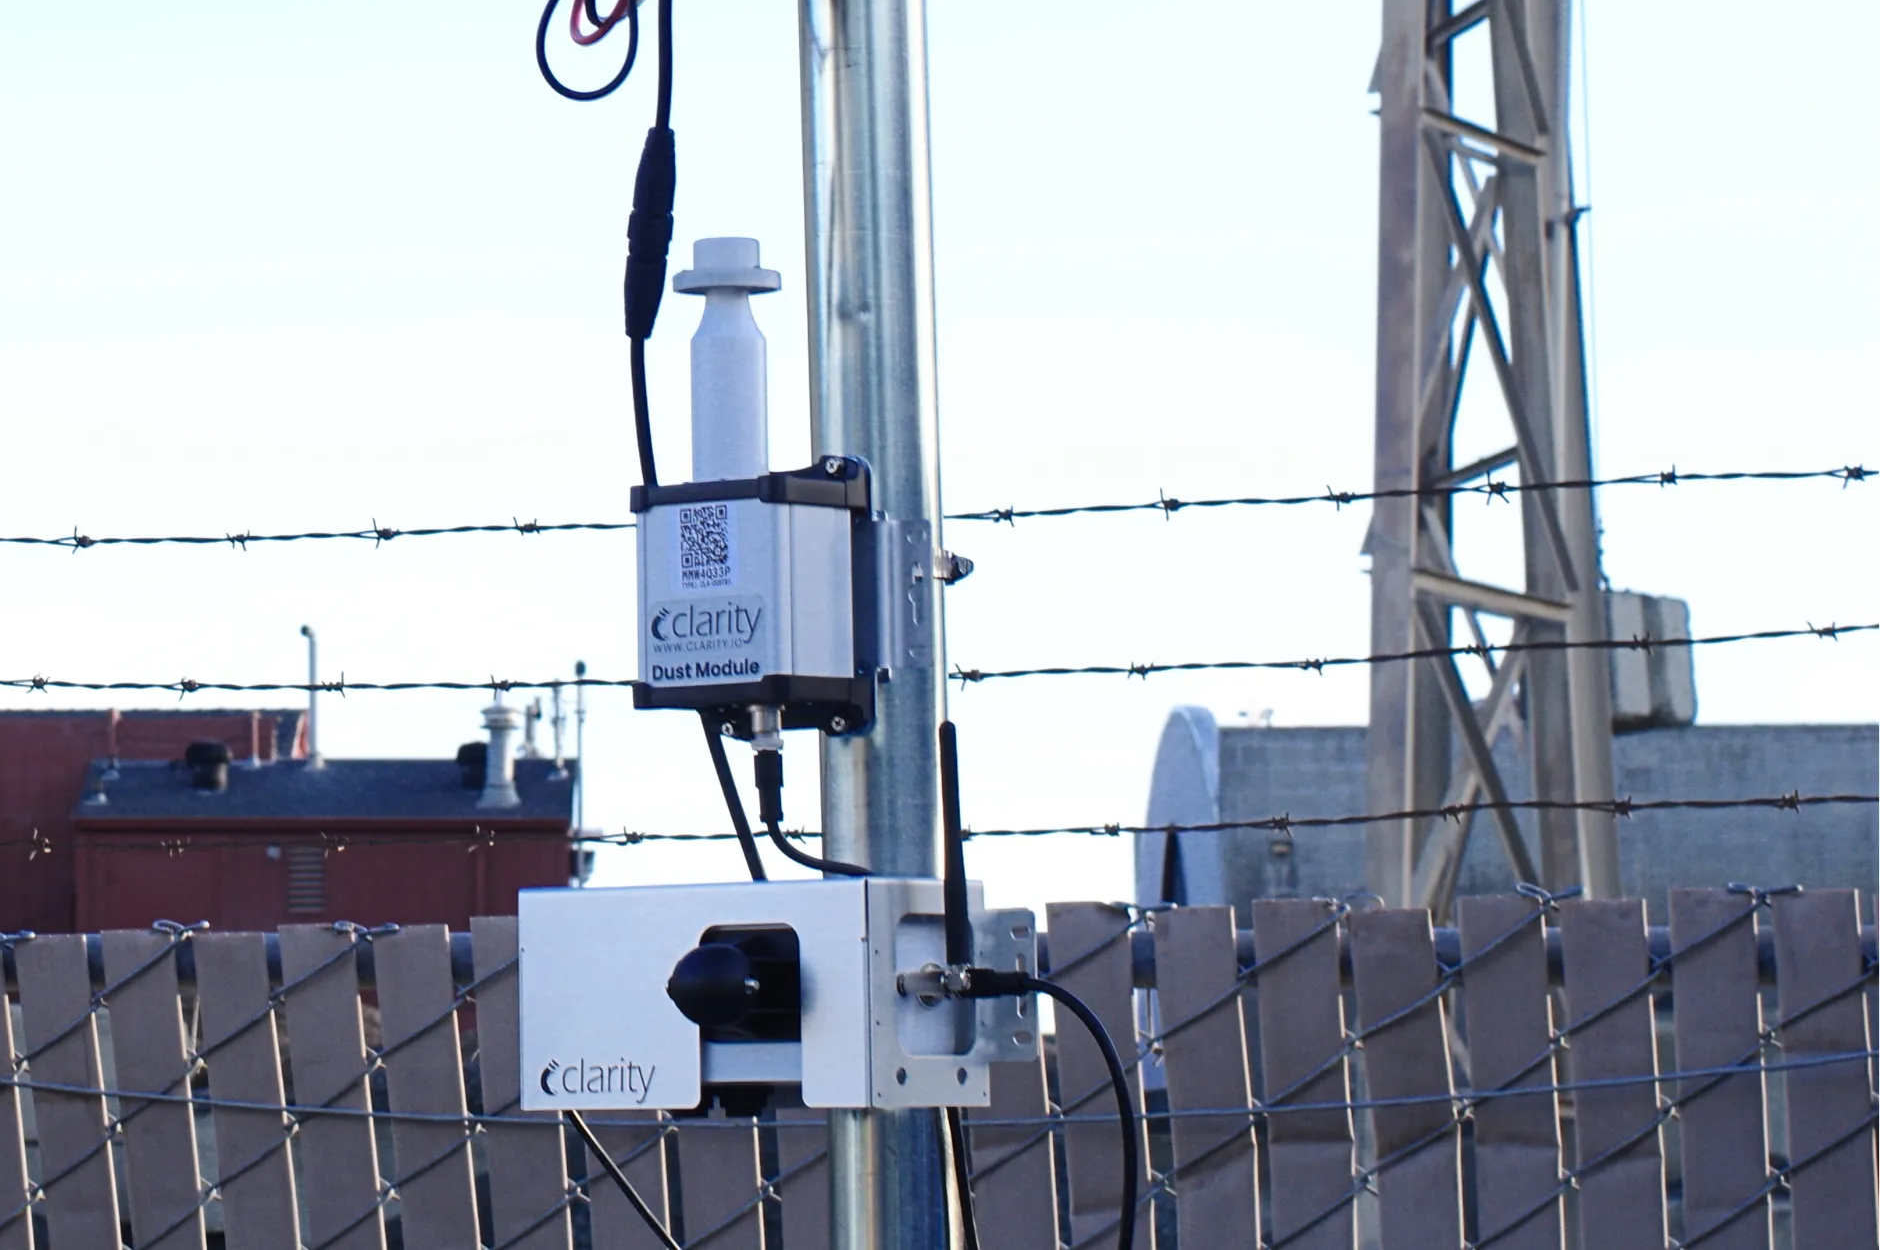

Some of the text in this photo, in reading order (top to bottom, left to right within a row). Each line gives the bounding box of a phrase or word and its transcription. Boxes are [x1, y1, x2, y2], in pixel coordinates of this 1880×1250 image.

[672, 601, 762, 644] clarity
[653, 638, 742, 653] WWW.CLARITY.IO
[652, 658, 760, 681] Dust Module
[562, 1056, 656, 1104] clarity
